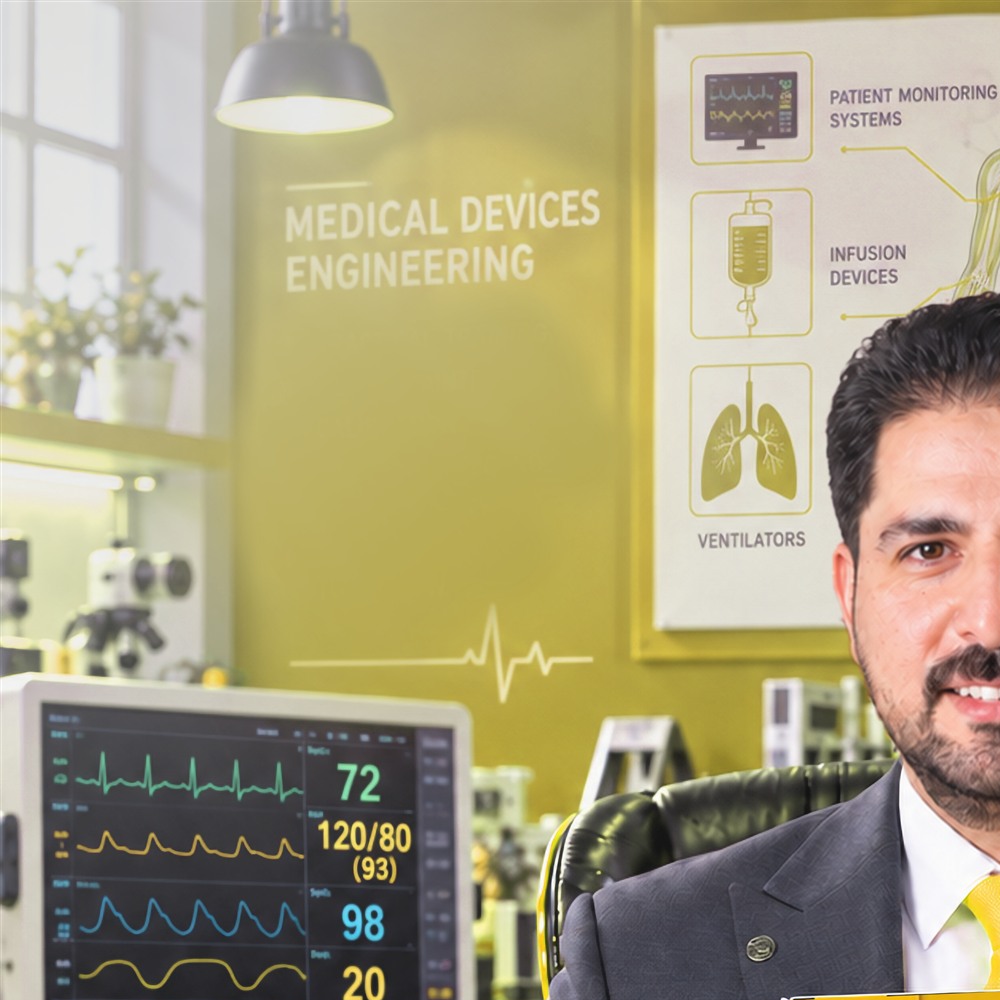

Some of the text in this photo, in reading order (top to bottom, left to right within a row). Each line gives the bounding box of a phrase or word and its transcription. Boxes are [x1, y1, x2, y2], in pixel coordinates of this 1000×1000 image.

[830, 84, 998, 105] PATIENT MONITORING
[830, 110, 903, 129] SYSTEMS
[285, 188, 601, 243] MEDICAL DEVICES
[830, 244, 907, 262] INFUSION
[285, 244, 535, 293] ENGINEERING
[830, 268, 899, 286] DEVICES
[697, 530, 806, 549] VENTILATORS
[336, 763, 381, 802] 72
[317, 819, 412, 853] 120/80
[352, 855, 398, 884] (93)
[341, 903, 385, 942] 98
